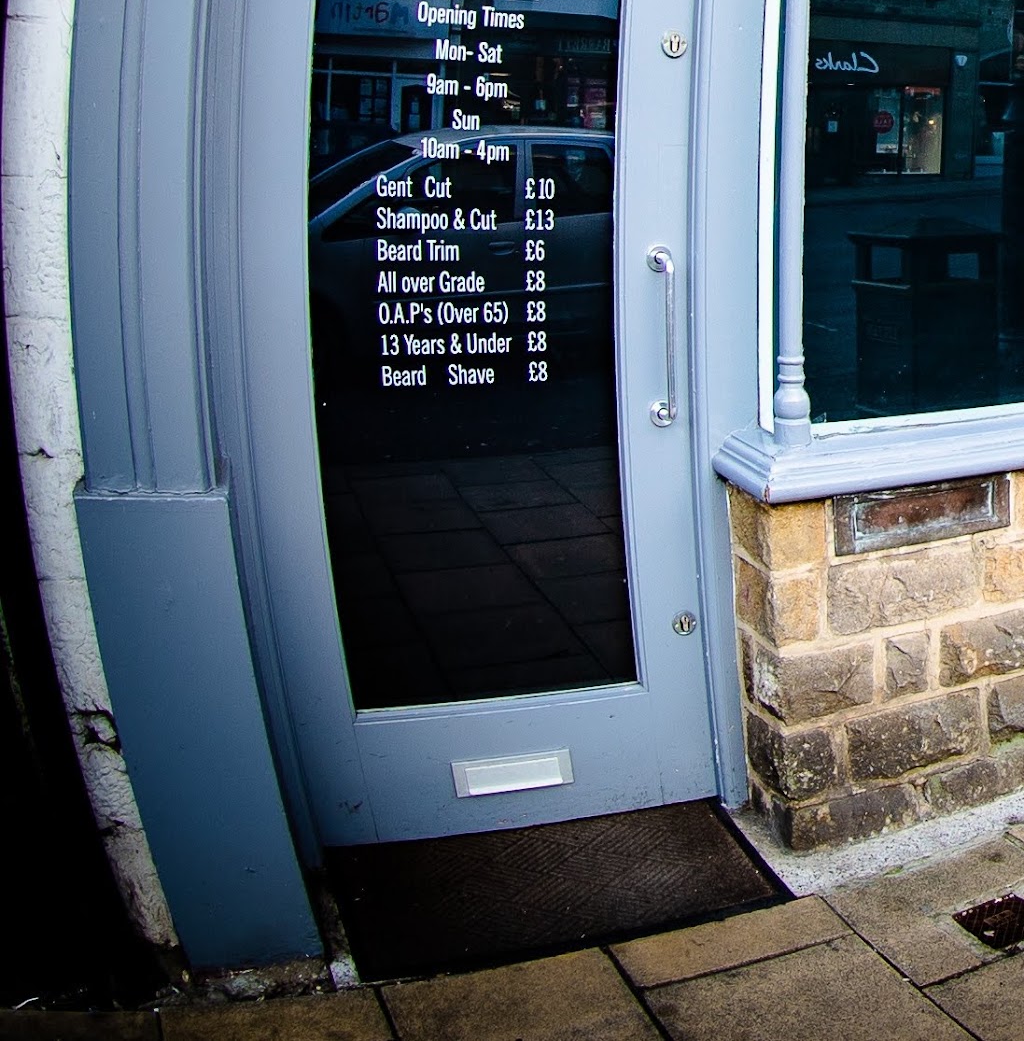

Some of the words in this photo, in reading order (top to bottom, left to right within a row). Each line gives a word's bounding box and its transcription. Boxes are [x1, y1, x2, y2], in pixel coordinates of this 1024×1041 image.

[418, 1, 476, 30] Opening
[482, 5, 525, 29] Times
[478, 42, 503, 63] Sat
[426, 73, 459, 96] 9am
[475, 76, 508, 101] 6pm
[452, 109, 480, 131] Sun
[420, 137, 460, 159] 10am
[477, 140, 510, 165] 4pm
[376, 174, 413, 198] Gent
[424, 175, 452, 198] Cut
[376, 207, 449, 234] Shampoo
[453, 207, 466, 230] &
[470, 208, 498, 231] Cut
[524, 209, 555, 231] £13
[377, 239, 422, 262] Beard
[426, 239, 460, 261] Trim
[525, 240, 545, 261] £6
[377, 271, 397, 293] All
[401, 273, 435, 293] over
[439, 270, 486, 293] Grade
[525, 270, 546, 292] £8
[378, 301, 433, 325] O.A.P's
[437, 301, 480, 326] (Over
[483, 300, 509, 325] 65)
[526, 300, 547, 322] £8
[381, 333, 400, 356] 13
[403, 333, 446, 356] Years
[450, 332, 463, 355] &
[466, 331, 513, 355] Under
[527, 331, 548, 352] £8
[381, 365, 427, 387] Beard
[448, 364, 495, 386] Shave
[528, 361, 548, 383] £8
